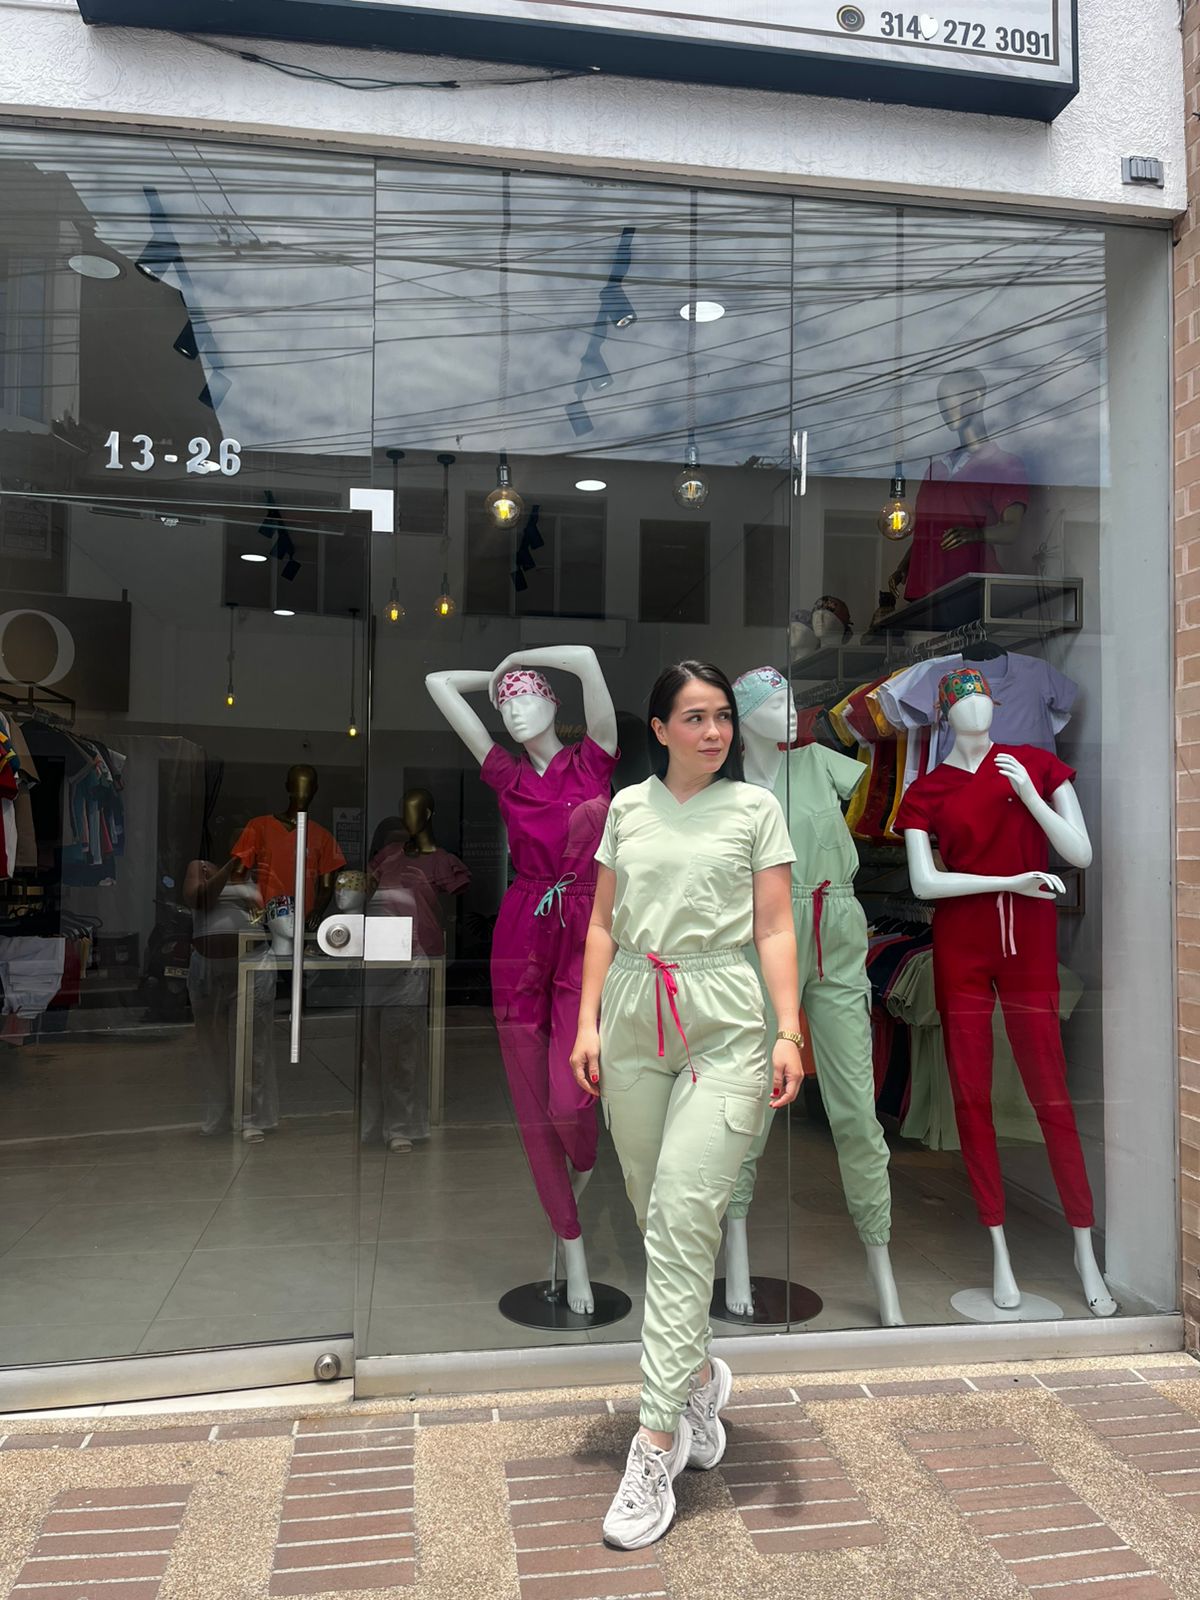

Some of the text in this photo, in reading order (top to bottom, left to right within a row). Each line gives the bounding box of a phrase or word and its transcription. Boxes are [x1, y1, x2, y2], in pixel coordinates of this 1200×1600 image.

[880, 11, 1050, 57] 314 272 3091
[104, 431, 241, 476] 13-26
